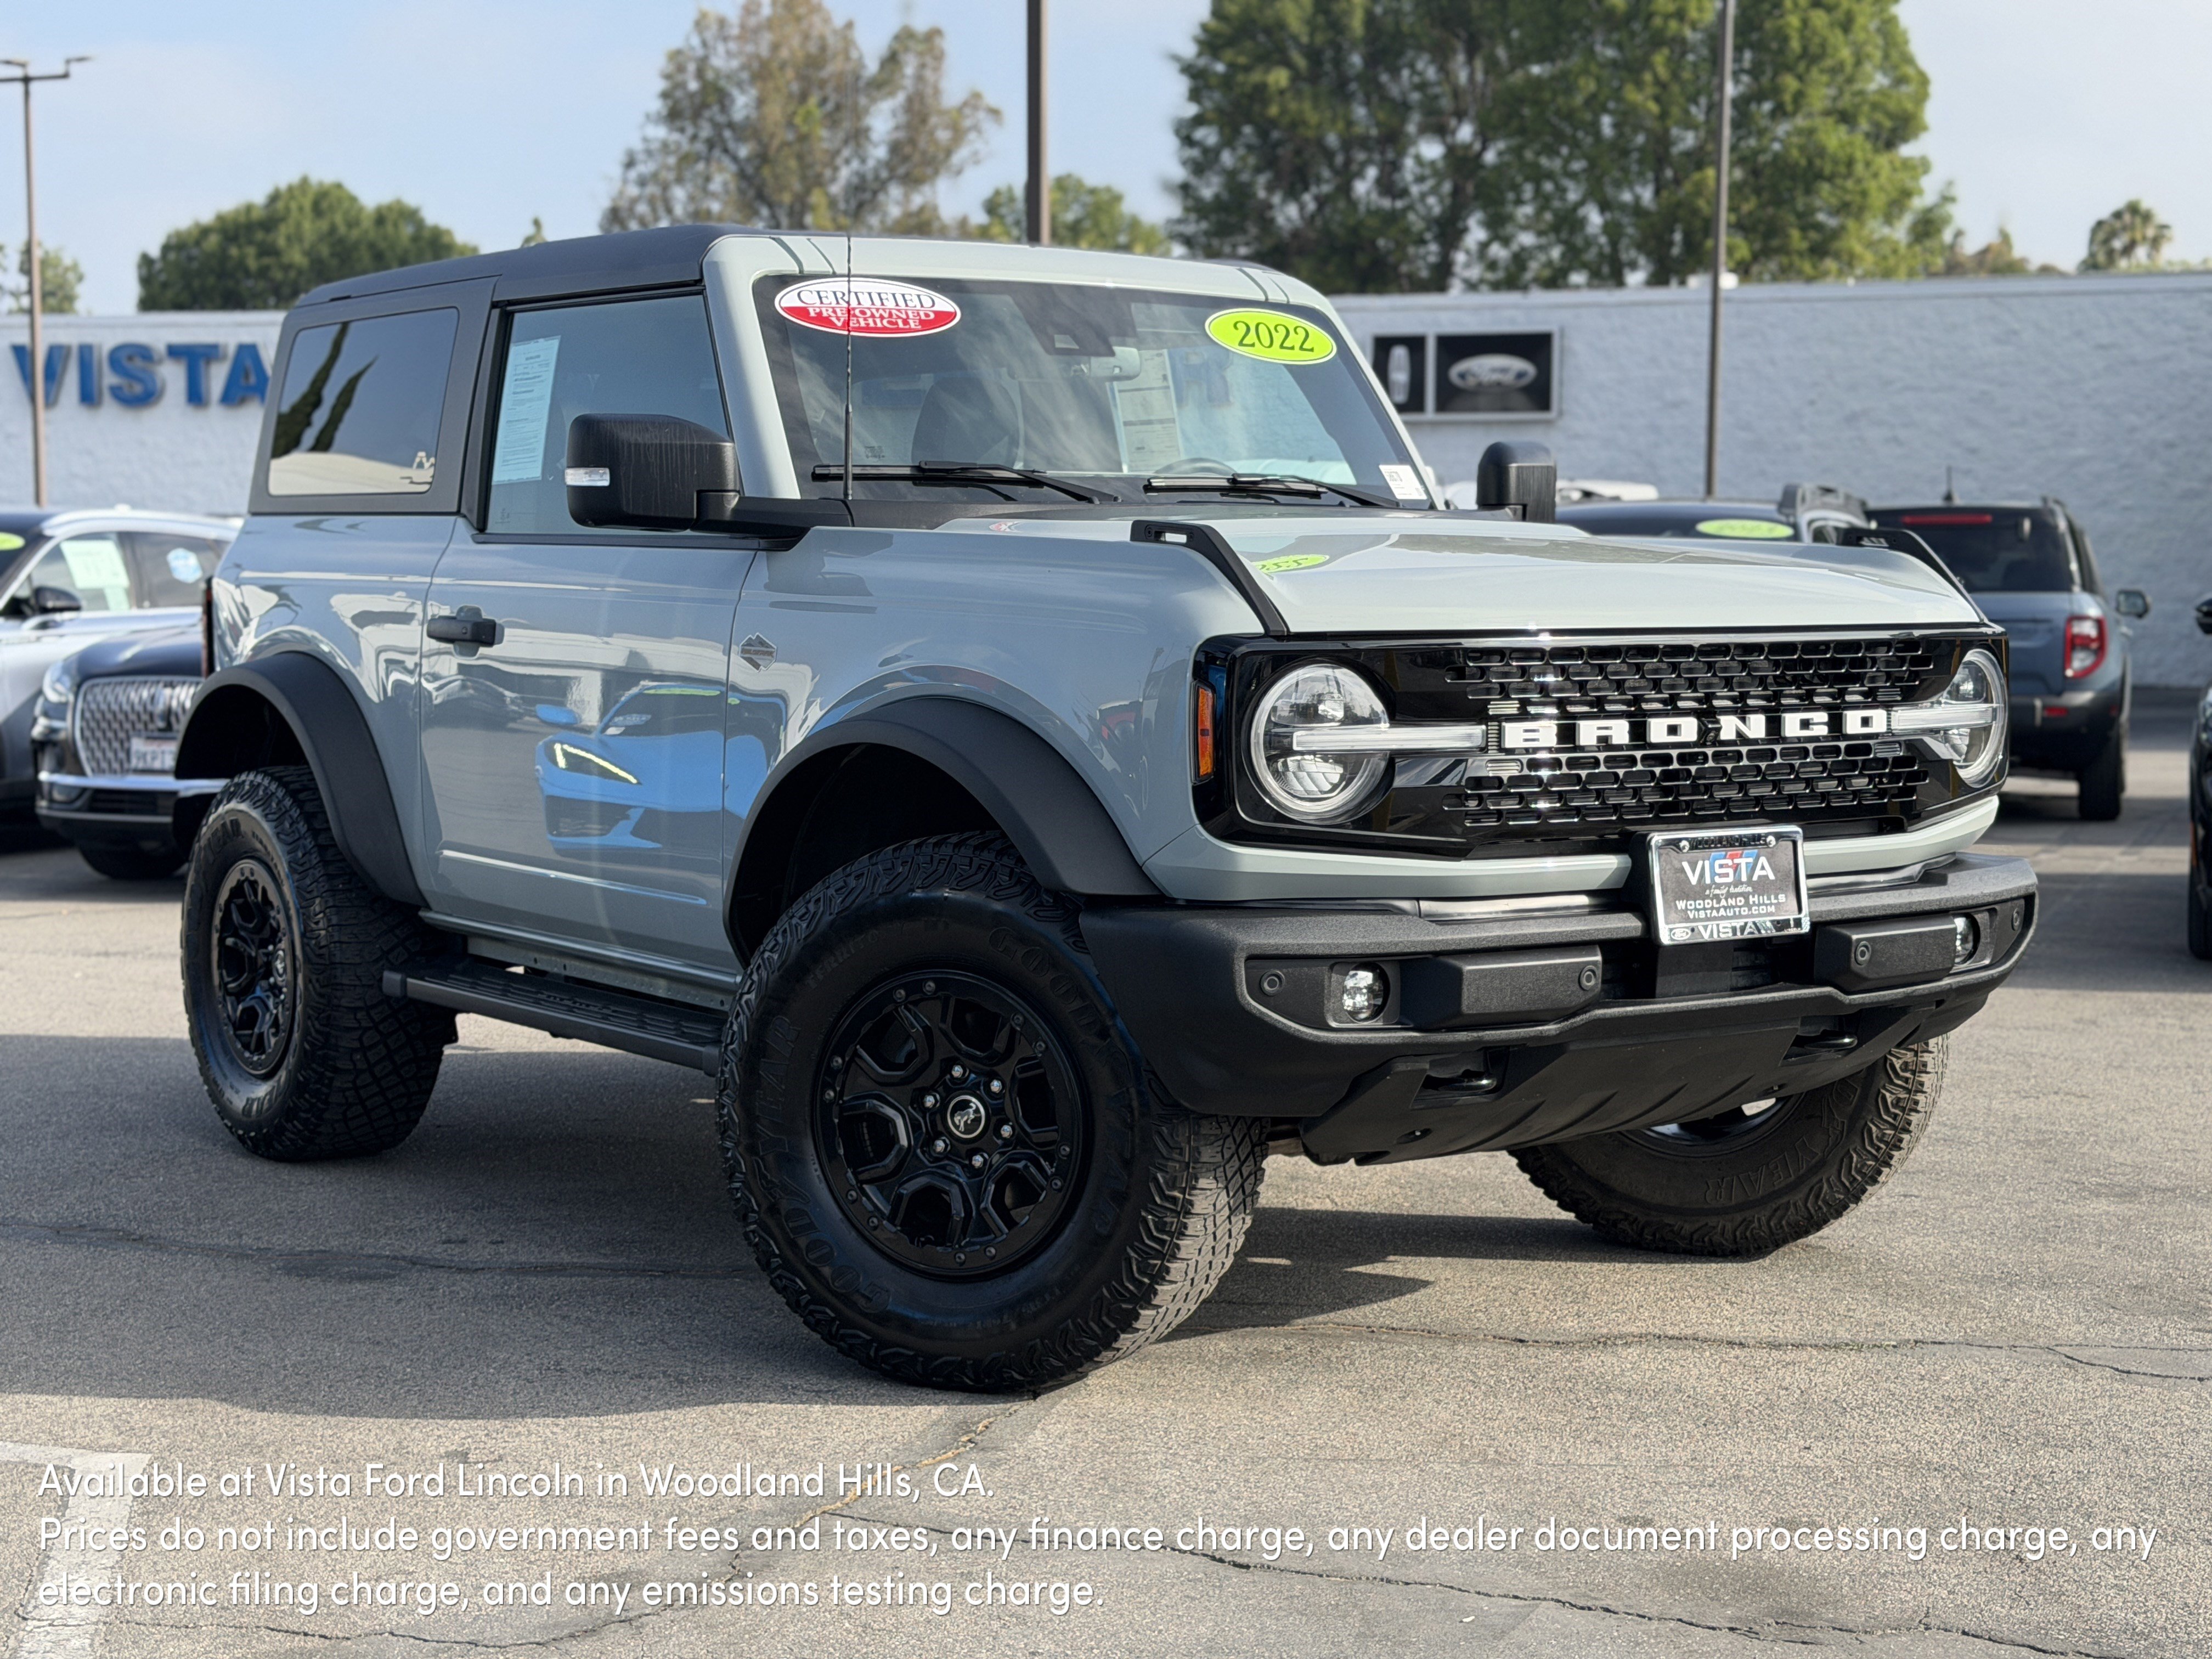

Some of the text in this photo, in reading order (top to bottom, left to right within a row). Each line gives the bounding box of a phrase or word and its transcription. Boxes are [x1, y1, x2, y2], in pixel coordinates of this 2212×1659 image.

[797, 290, 936, 309] CERTIFIED
[829, 317, 922, 329] VEHICLE
[1233, 320, 1314, 353] 2022
[10, 342, 270, 407] VISTA
[1501, 708, 1889, 749] BRONCO
[1681, 856, 1775, 885] VISTA
[1675, 894, 1786, 910] WOODLAND HILLS
[1697, 921, 1759, 940] VISTA
